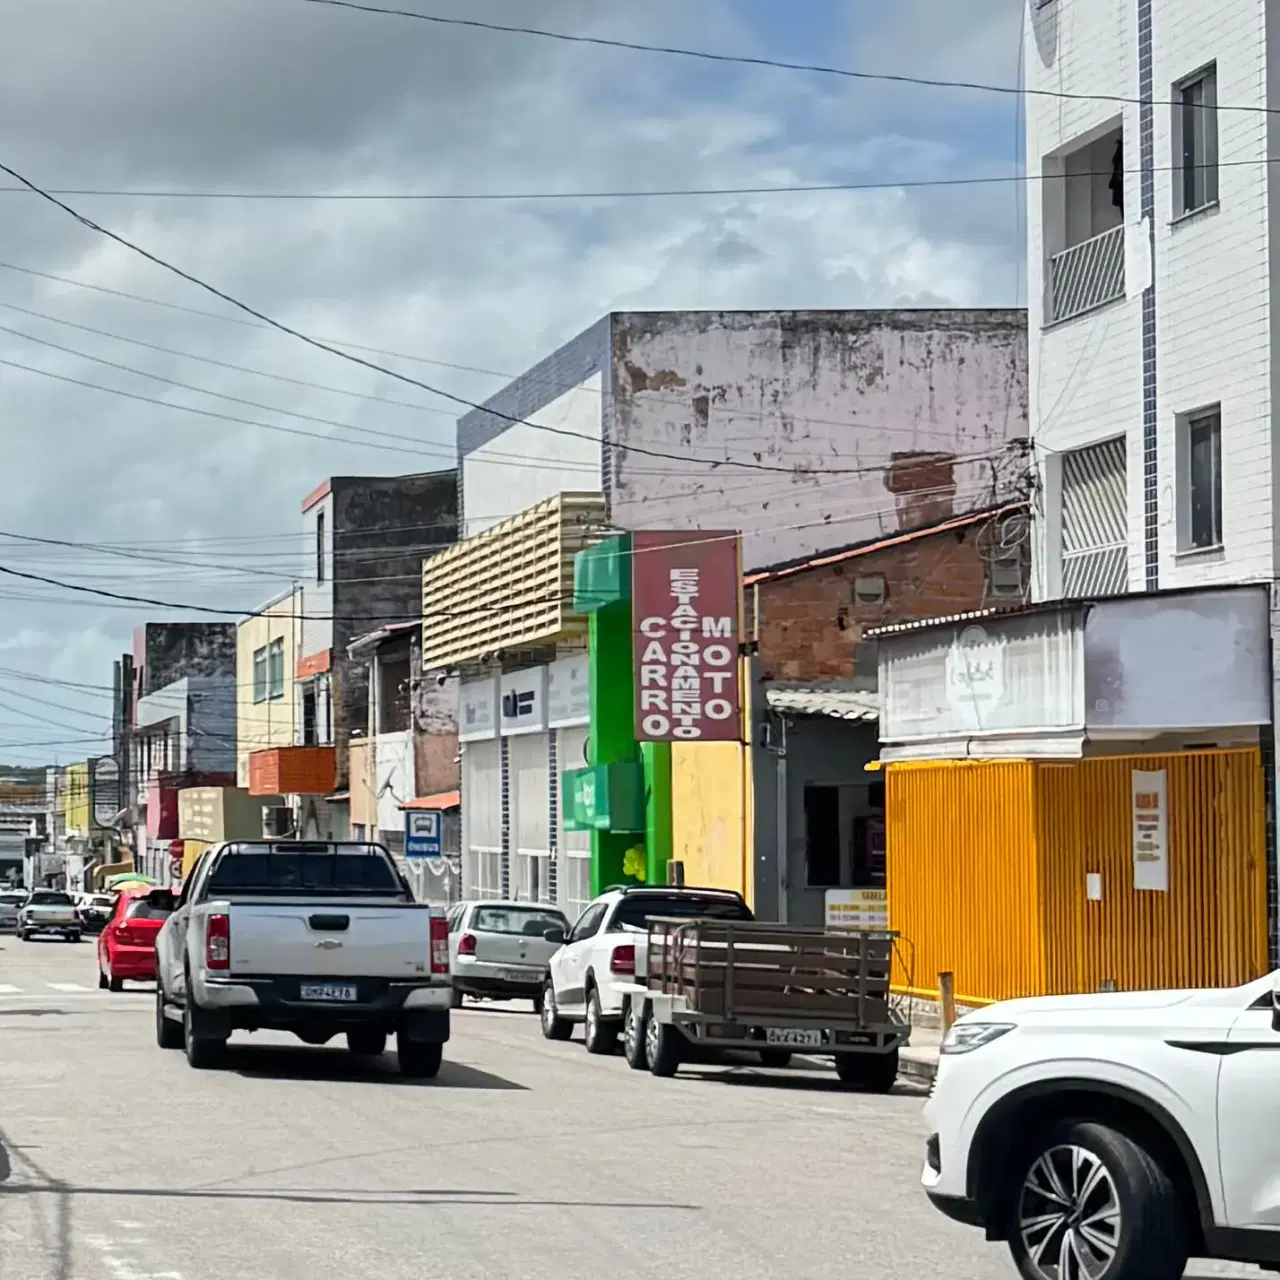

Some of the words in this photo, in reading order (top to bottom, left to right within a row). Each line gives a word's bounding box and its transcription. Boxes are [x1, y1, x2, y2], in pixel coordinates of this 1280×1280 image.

[640, 616, 670, 737] CARRO
[669, 568, 702, 738] ESTACIONAMENTO
[701, 616, 732, 720] MOTO
